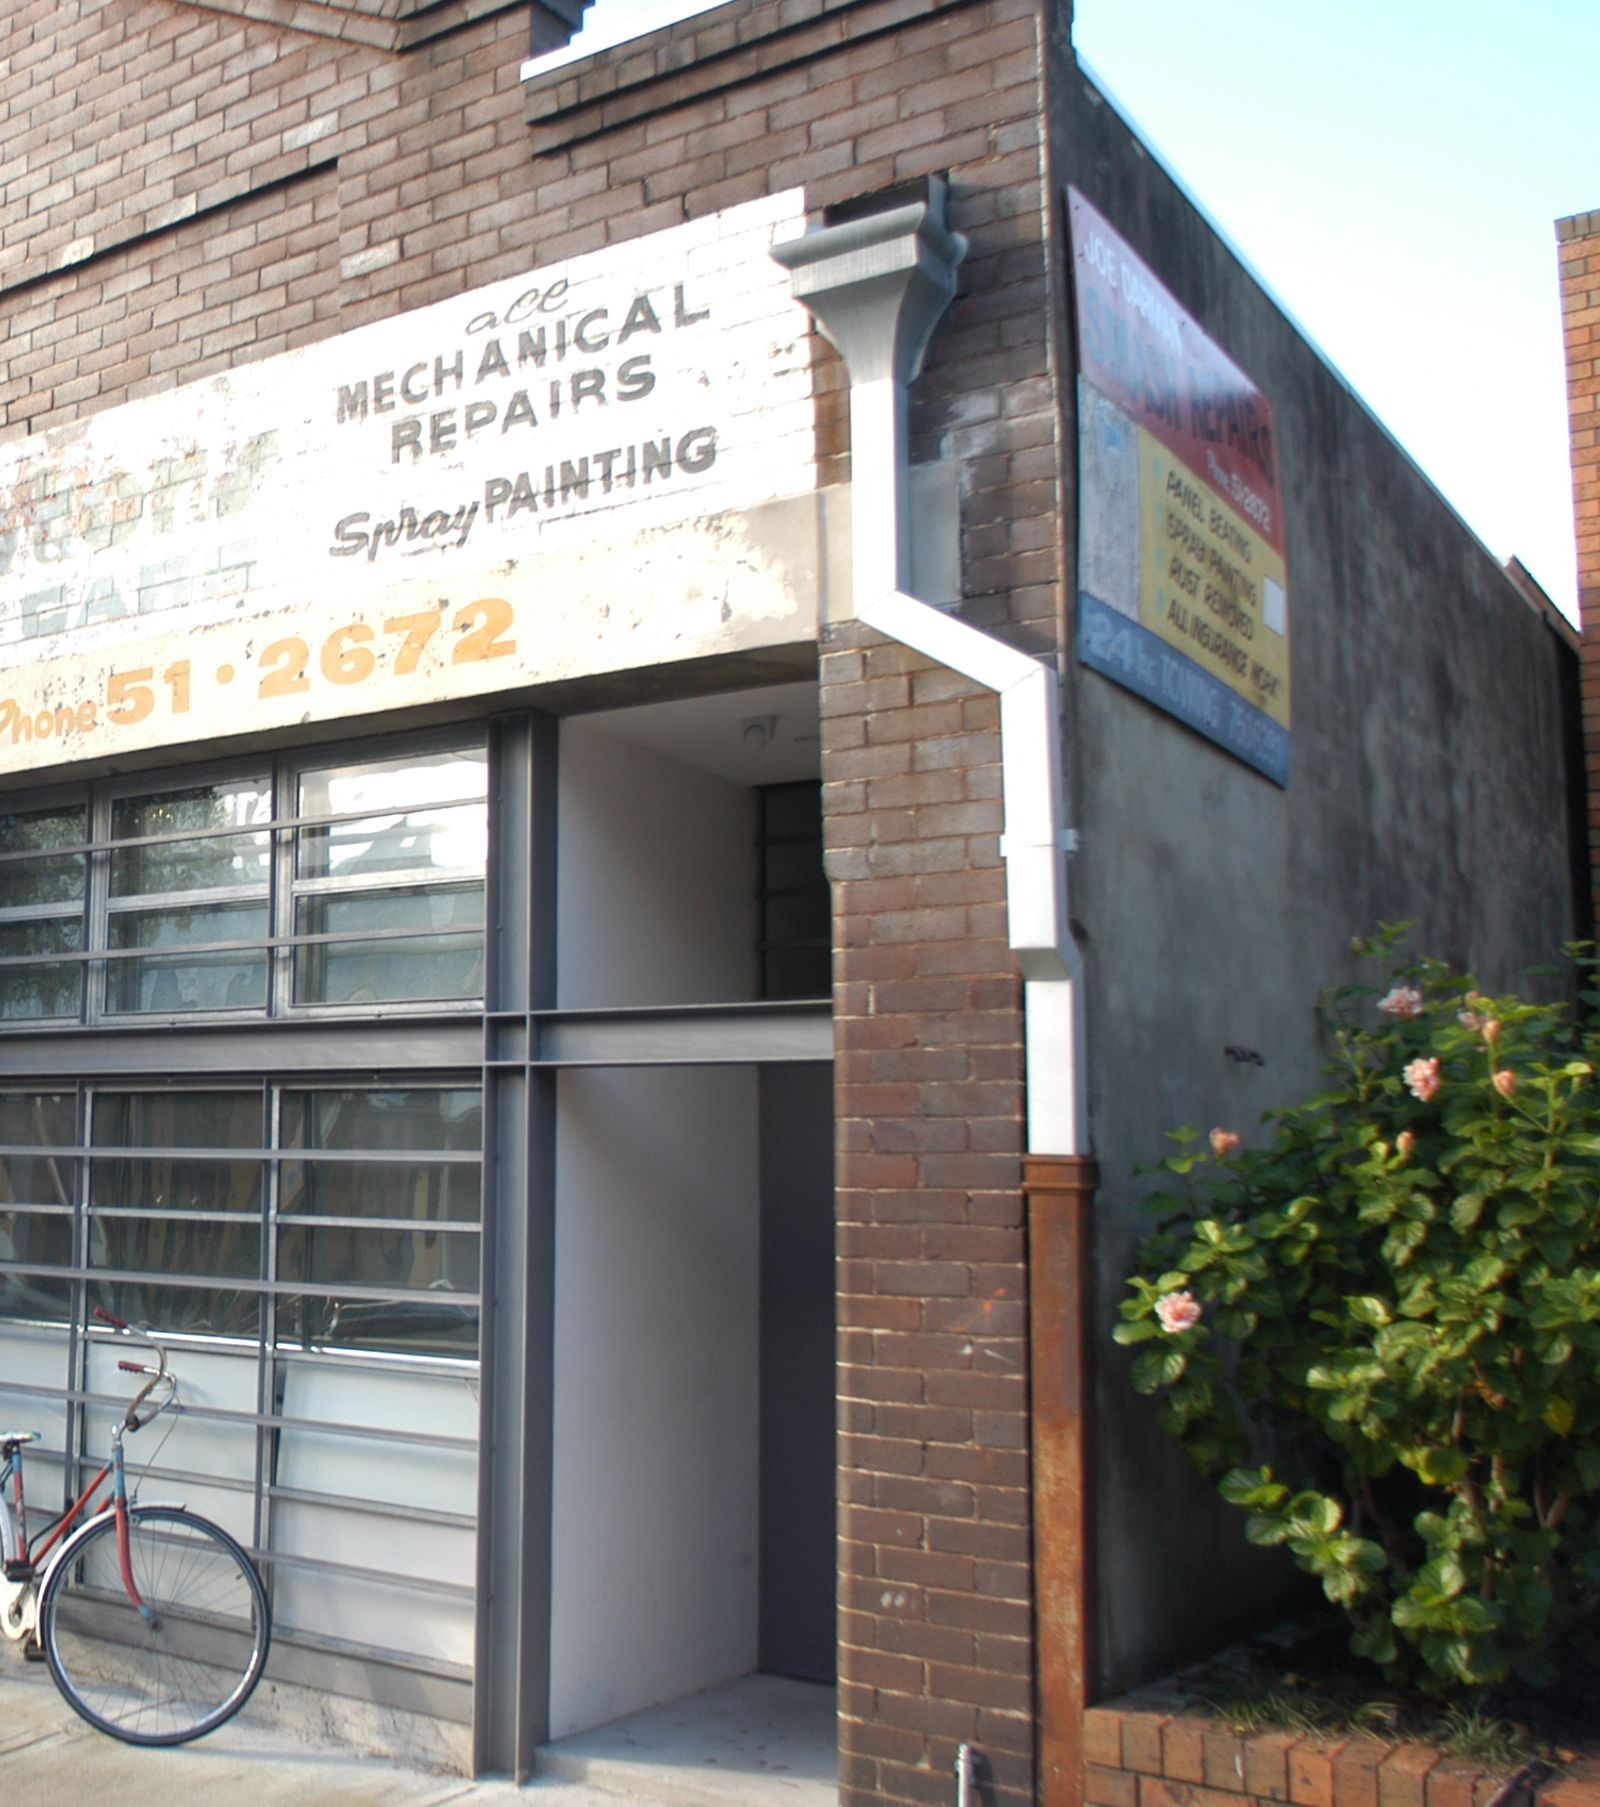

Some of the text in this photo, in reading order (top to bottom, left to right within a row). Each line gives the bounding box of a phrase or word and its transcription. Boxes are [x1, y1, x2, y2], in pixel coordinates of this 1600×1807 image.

[1084, 230, 1117, 288] JOE
[336, 285, 711, 424] MECHANICAL
[466, 278, 568, 337] all
[391, 354, 656, 464] REPAIRS
[329, 425, 718, 561] Spray PAINTING
[1166, 470, 1251, 563] PANEL BEATING
[1166, 512, 1257, 608] SPRAY PAINTING
[1168, 555, 1253, 641] RUST REMOVED
[1168, 598, 1280, 699] ALL INSURANCE WORK
